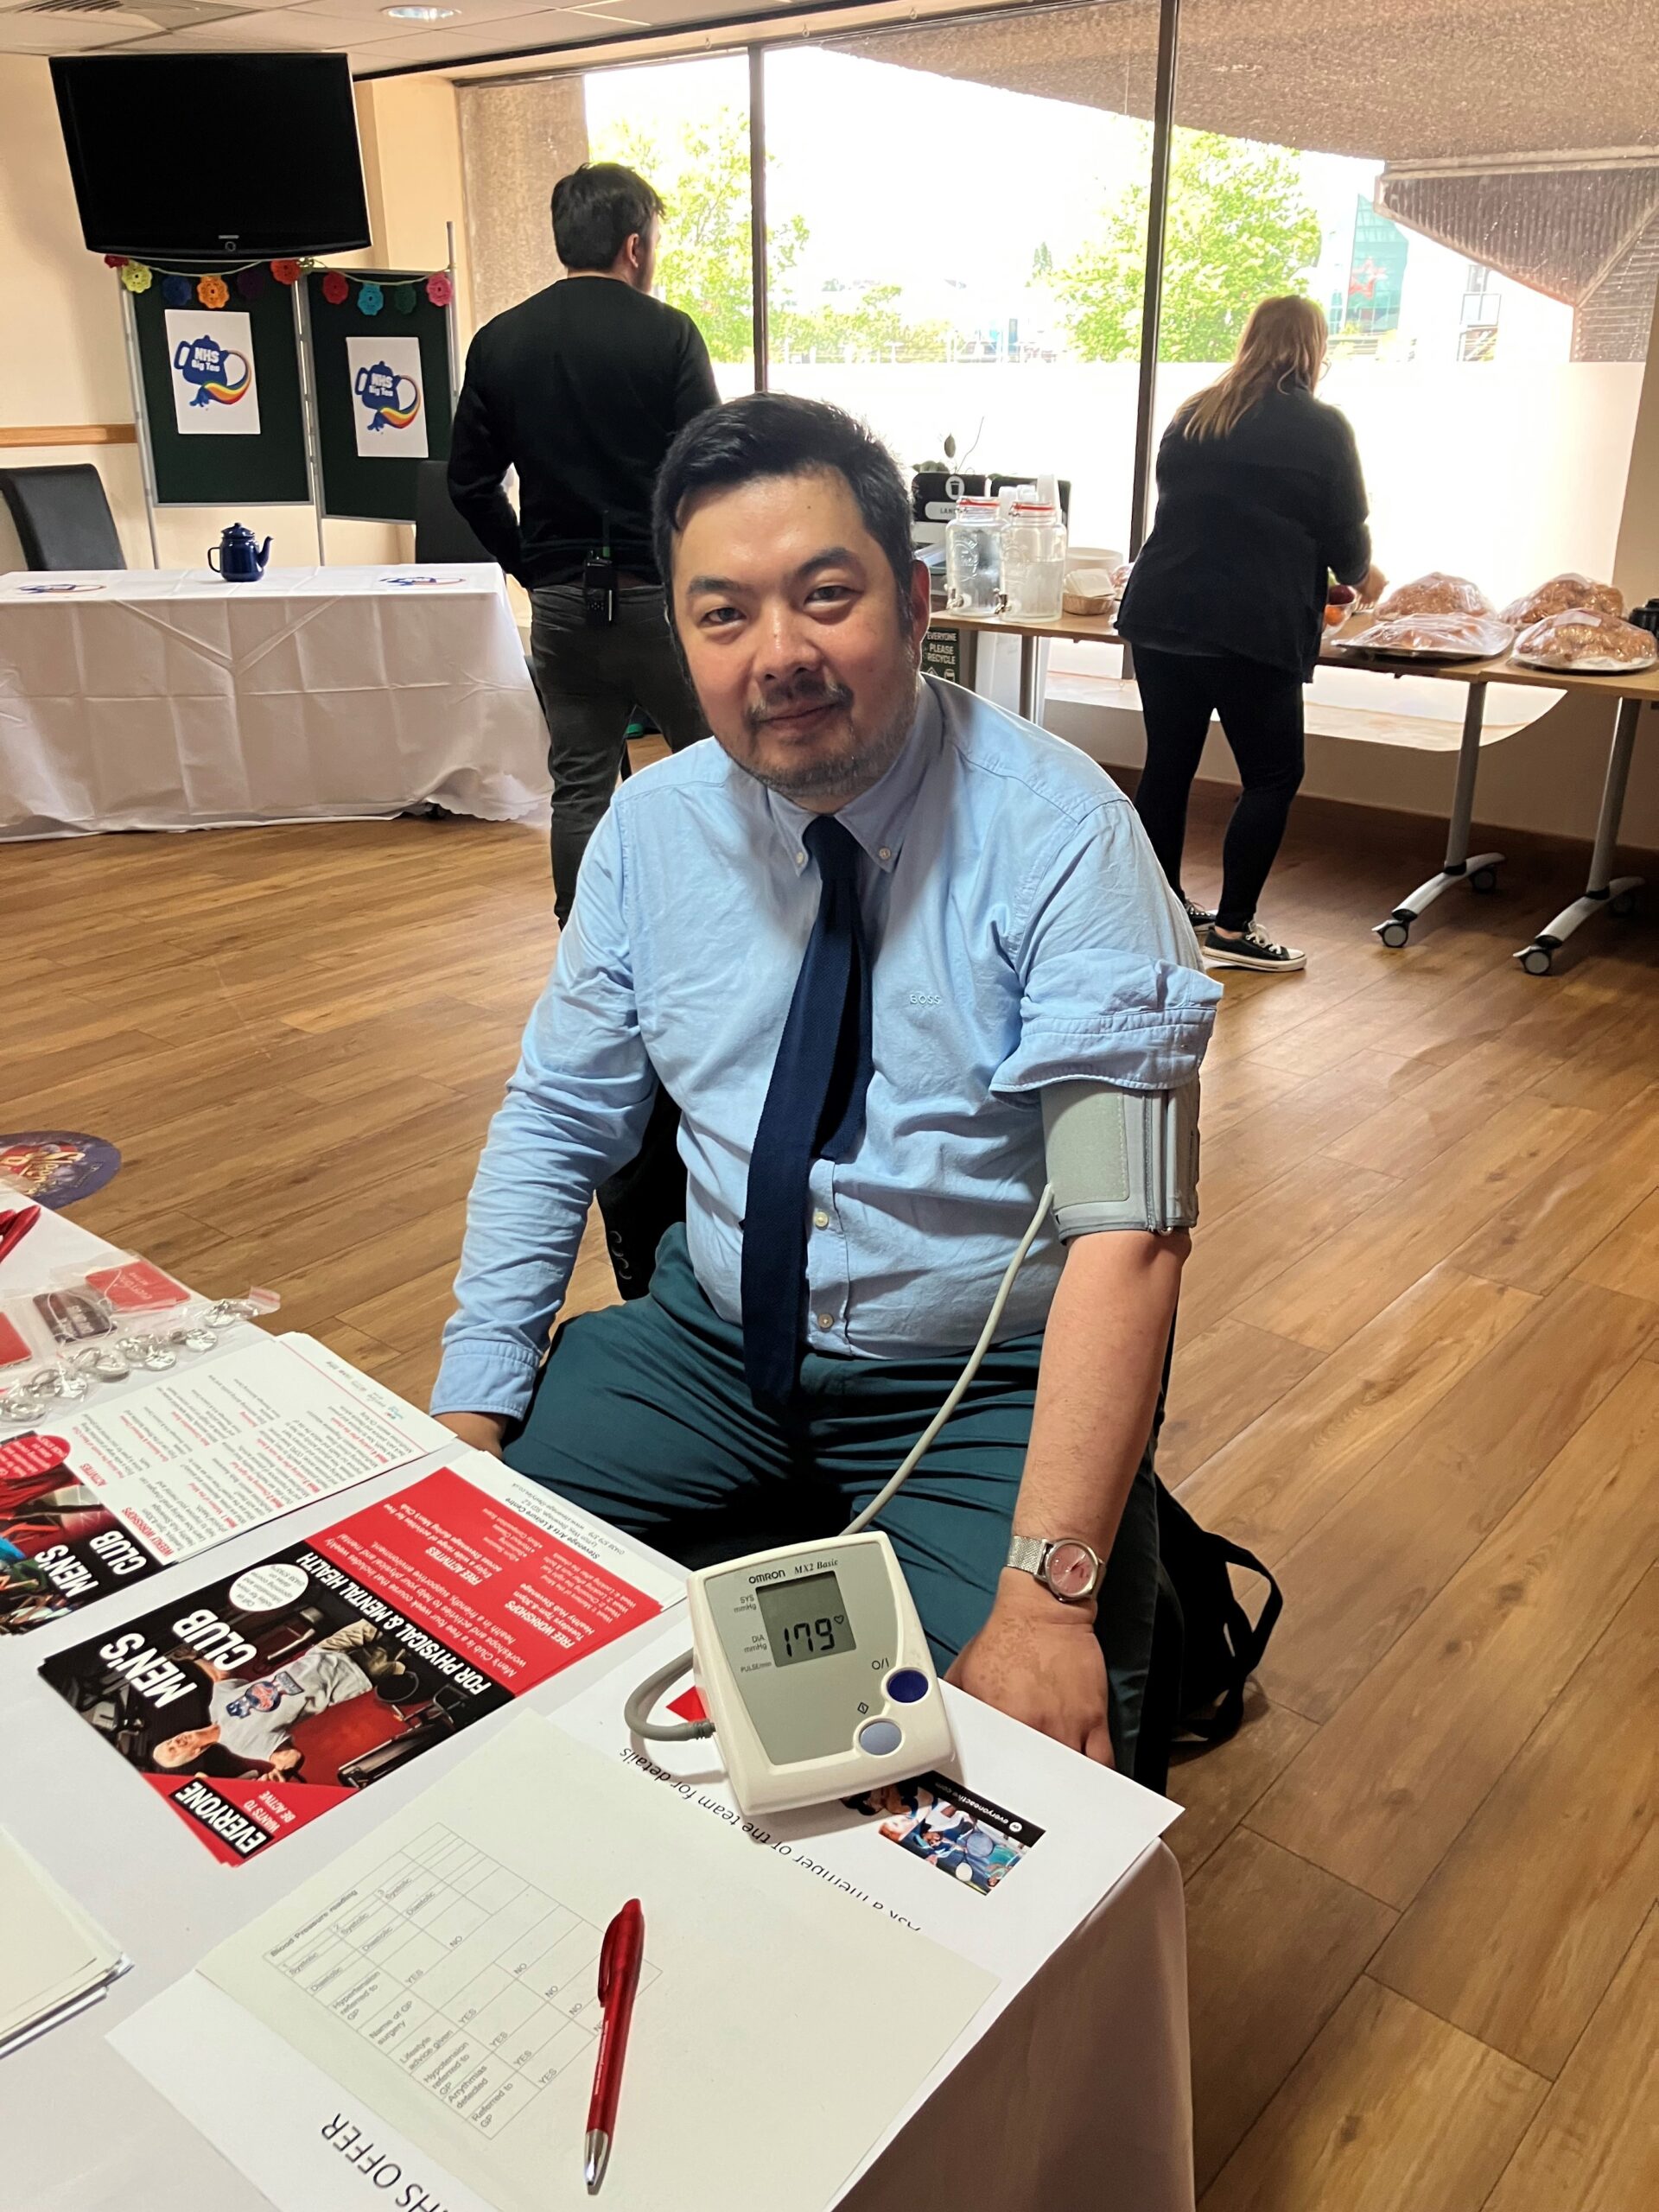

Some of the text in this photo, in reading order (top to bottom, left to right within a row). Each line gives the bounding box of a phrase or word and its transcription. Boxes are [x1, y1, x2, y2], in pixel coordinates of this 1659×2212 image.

[192, 359, 203, 370] Big
[194, 346, 220, 364] NHS
[368, 385, 379, 396] Big
[371, 372, 393, 389] NHS
[927, 632, 957, 642] EVERYONE
[929, 643, 954, 655] PLEASE
[927, 653, 956, 664] RECYCLE
[910, 994, 941, 1005] BOSS
[502, 1497, 527, 1512] Centre
[523, 1510, 549, 1526] Leisure
[335, 1532, 365, 1552] mental
[550, 1528, 568, 1538] Arts
[89, 1530, 147, 1575] CLUB
[321, 1536, 353, 1557] weekly
[358, 1548, 378, 1560] and
[564, 1535, 601, 1559] Stevenage
[294, 1551, 350, 1589] HEALTH
[343, 1554, 378, 1577] includes
[370, 1556, 405, 1580] physical
[423, 1545, 483, 1586] FREE ACTIVITIES
[748, 1569, 785, 1584] OMRON
[817, 1559, 838, 1569] Basic
[371, 1573, 391, 1586] that
[398, 1575, 422, 1590] your
[410, 1569, 453, 1598] supportive
[334, 1581, 395, 1622] MENTAL
[386, 1583, 414, 1602] course
[413, 1587, 436, 1602] help
[741, 1594, 754, 1604] SYS
[408, 1599, 434, 1617] week
[426, 1613, 448, 1627] four
[734, 1603, 757, 1613] mmHg
[378, 1614, 406, 1631] &
[442, 1624, 464, 1638] free
[467, 1626, 488, 1640] and
[486, 1624, 517, 1644] health
[502, 1599, 576, 1649] FREE WORKSHOPS
[166, 1606, 262, 1673] CLUB
[391, 1623, 466, 1675] PHYSICAL
[744, 1643, 767, 1653] mmHg
[784, 1618, 835, 1657] 179
[469, 1644, 495, 1662] Club
[481, 1636, 529, 1669] workshops
[92, 1630, 200, 1709] MEN'S
[450, 1666, 493, 1695] FOR
[615, 1745, 673, 1785] details
[666, 1778, 697, 1802] for
[175, 1780, 267, 1853] EVERYONE
[242, 1799, 283, 1832] WANTS TO
[257, 1790, 296, 1821] BE ACTIVE
[695, 1794, 741, 1827] team
[739, 1821, 772, 1845] the
[339, 1911, 371, 1936] Systolic
[383, 1877, 414, 1901] Systolic
[269, 1888, 359, 1957] Blood Pressure reading
[309, 1890, 436, 1993] Diastolic Diastolic Diastolic
[404, 1935, 464, 1985] YES NO
[330, 1968, 382, 2011] Hypertension
[456, 1961, 529, 2025] YES NO
[339, 1990, 370, 2016] referred
[345, 2007, 361, 2021] GP
[368, 2018, 394, 2039] Name
[398, 1999, 415, 2012] GP
[488, 1984, 560, 2049] YES NO
[376, 2019, 408, 2046] surgery
[512, 2001, 584, 2067] YES NO
[398, 2035, 434, 2065] Lifestyle
[406, 2029, 455, 2070] advice given
[422, 2041, 472, 2084] Hypotension
[429, 2061, 462, 2089] referred
[537, 2067, 558, 2086] YES
[437, 2081, 454, 2096] GP
[454, 2077, 489, 2108] detected
[470, 2089, 506, 2122] Referred
[478, 2113, 496, 2128] GP
[321, 2113, 401, 2189] OFFER
[395, 2183, 448, 2212] HS
